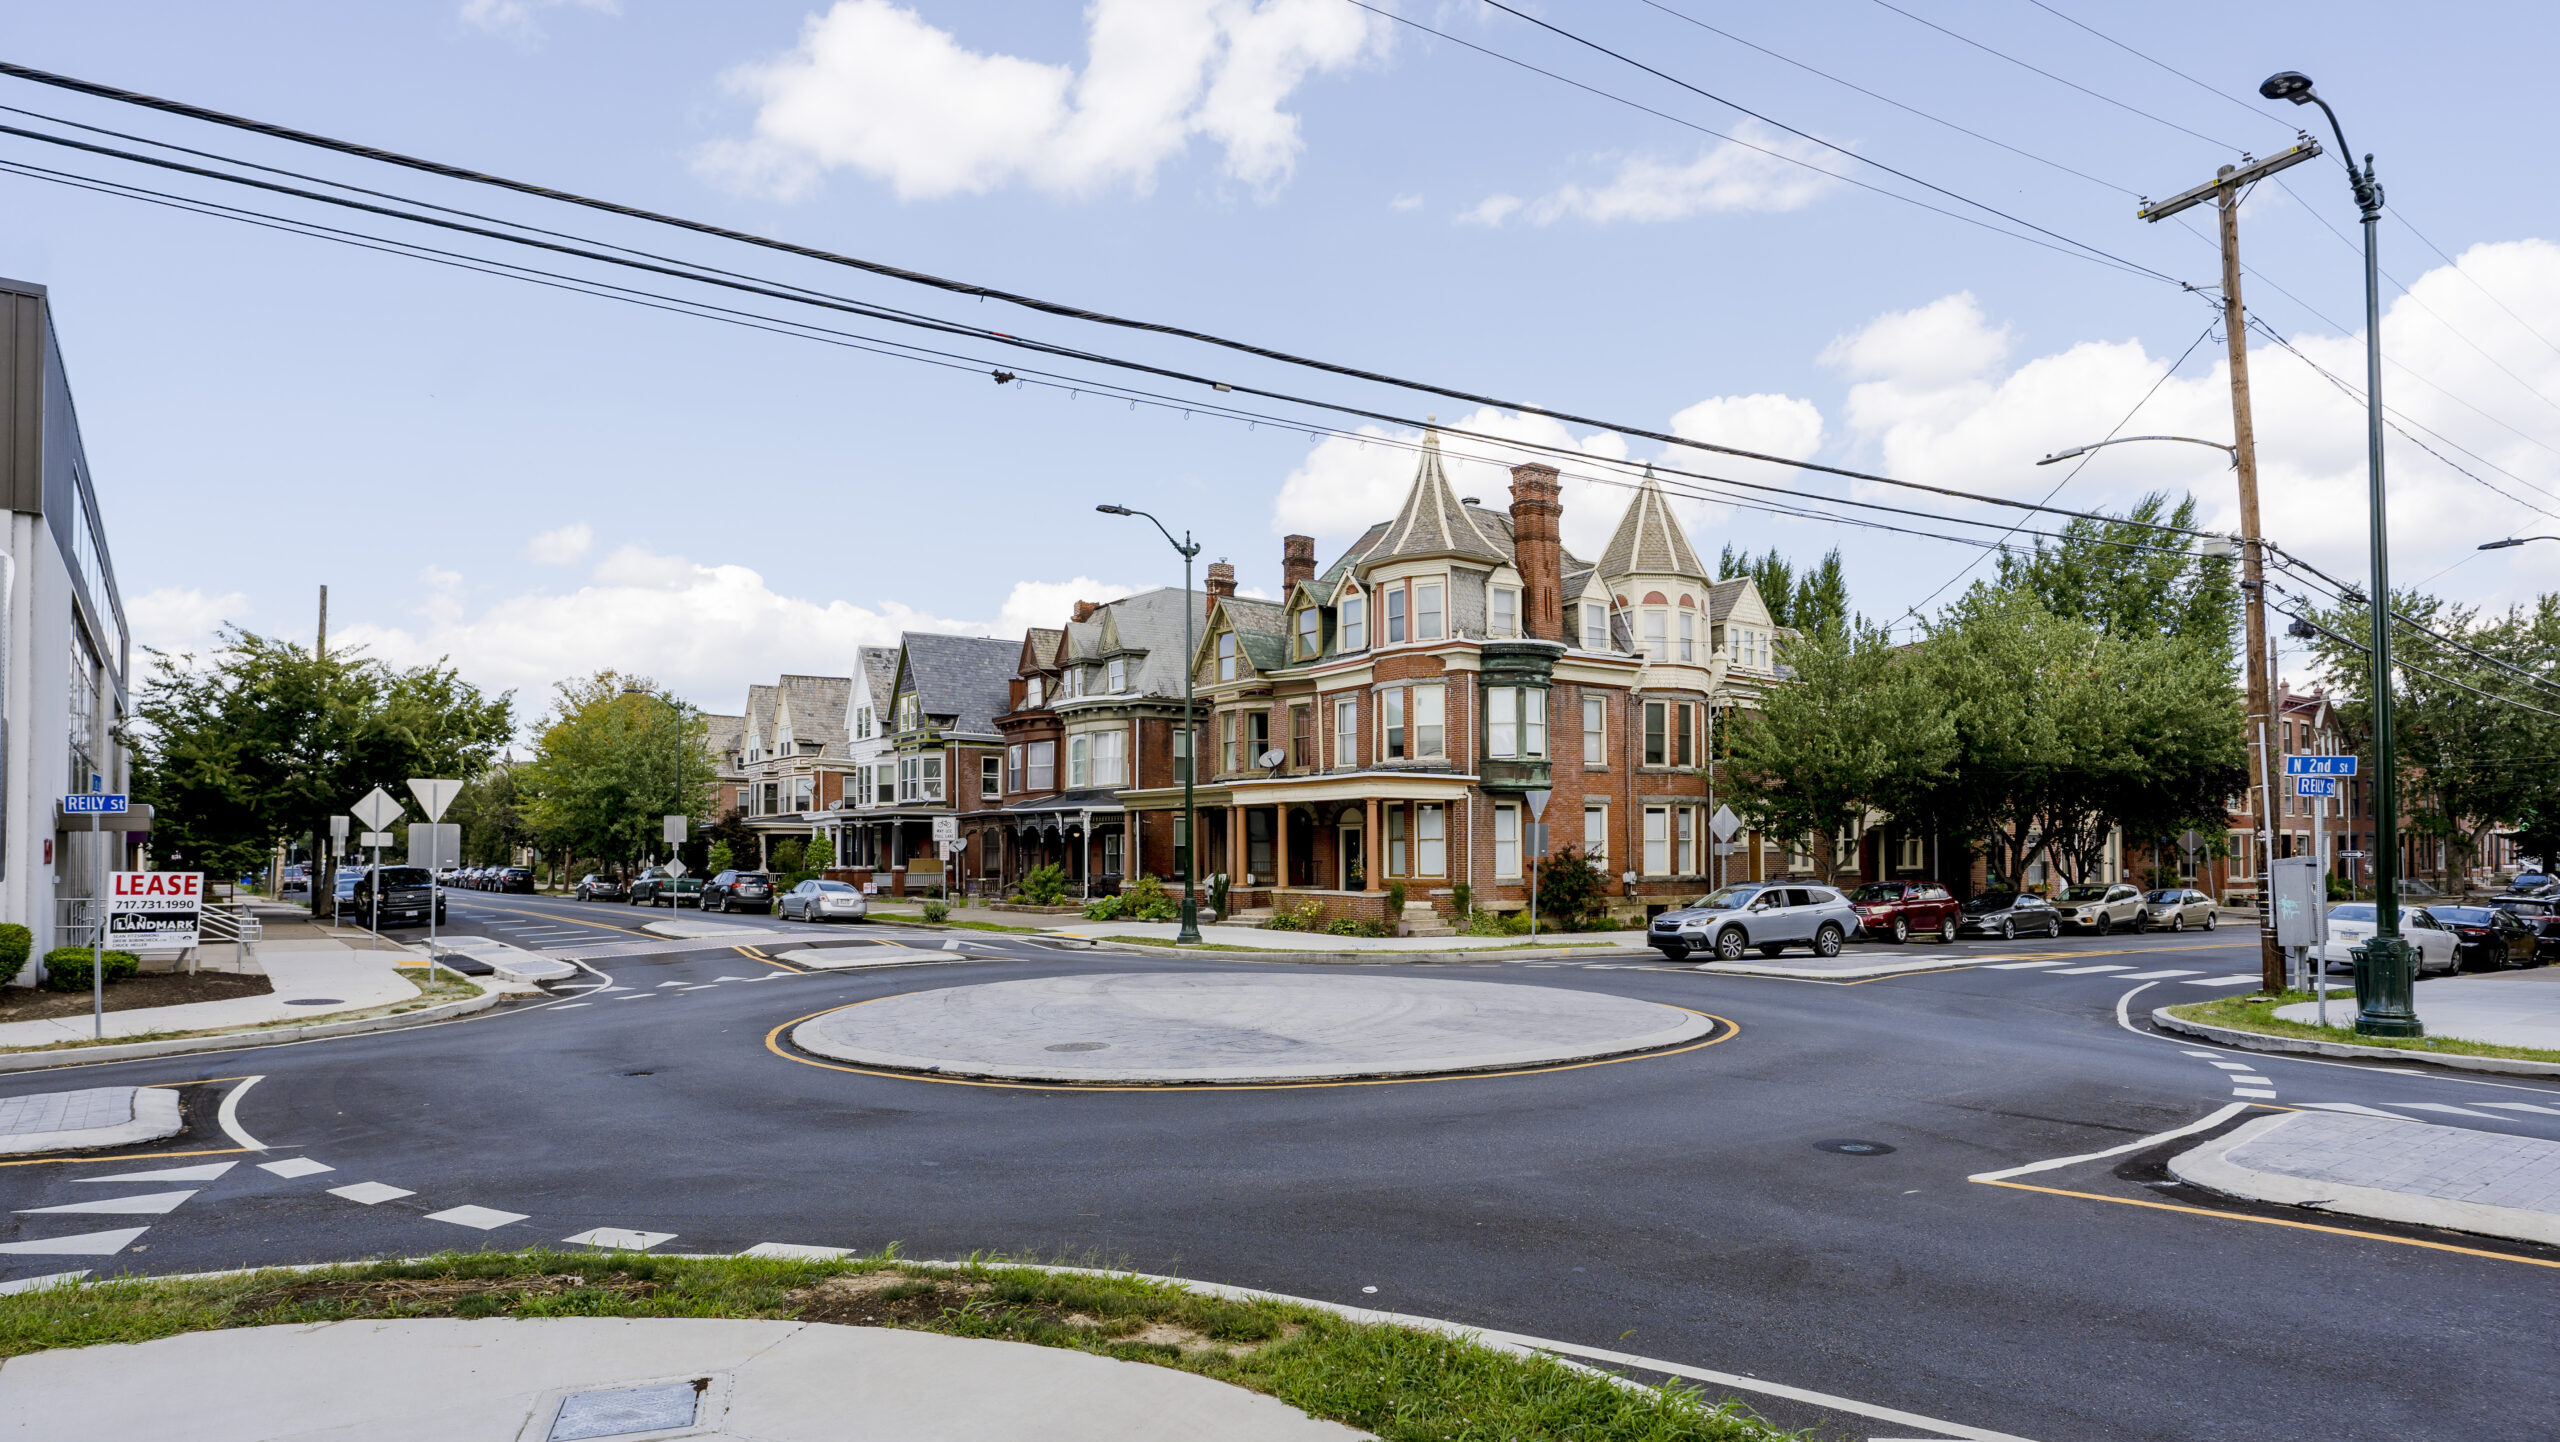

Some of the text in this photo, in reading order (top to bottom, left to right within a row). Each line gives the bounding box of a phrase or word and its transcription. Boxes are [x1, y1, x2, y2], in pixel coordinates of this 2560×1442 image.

[2293, 758, 2302, 773] N
[2309, 758, 2332, 773] 2nd
[2301, 778, 2325, 793] REILY
[68, 796, 106, 810] REILY
[115, 875, 198, 895] LEASE
[115, 900, 194, 909] 717.731.1990
[118, 920, 195, 930] LANDMARK
